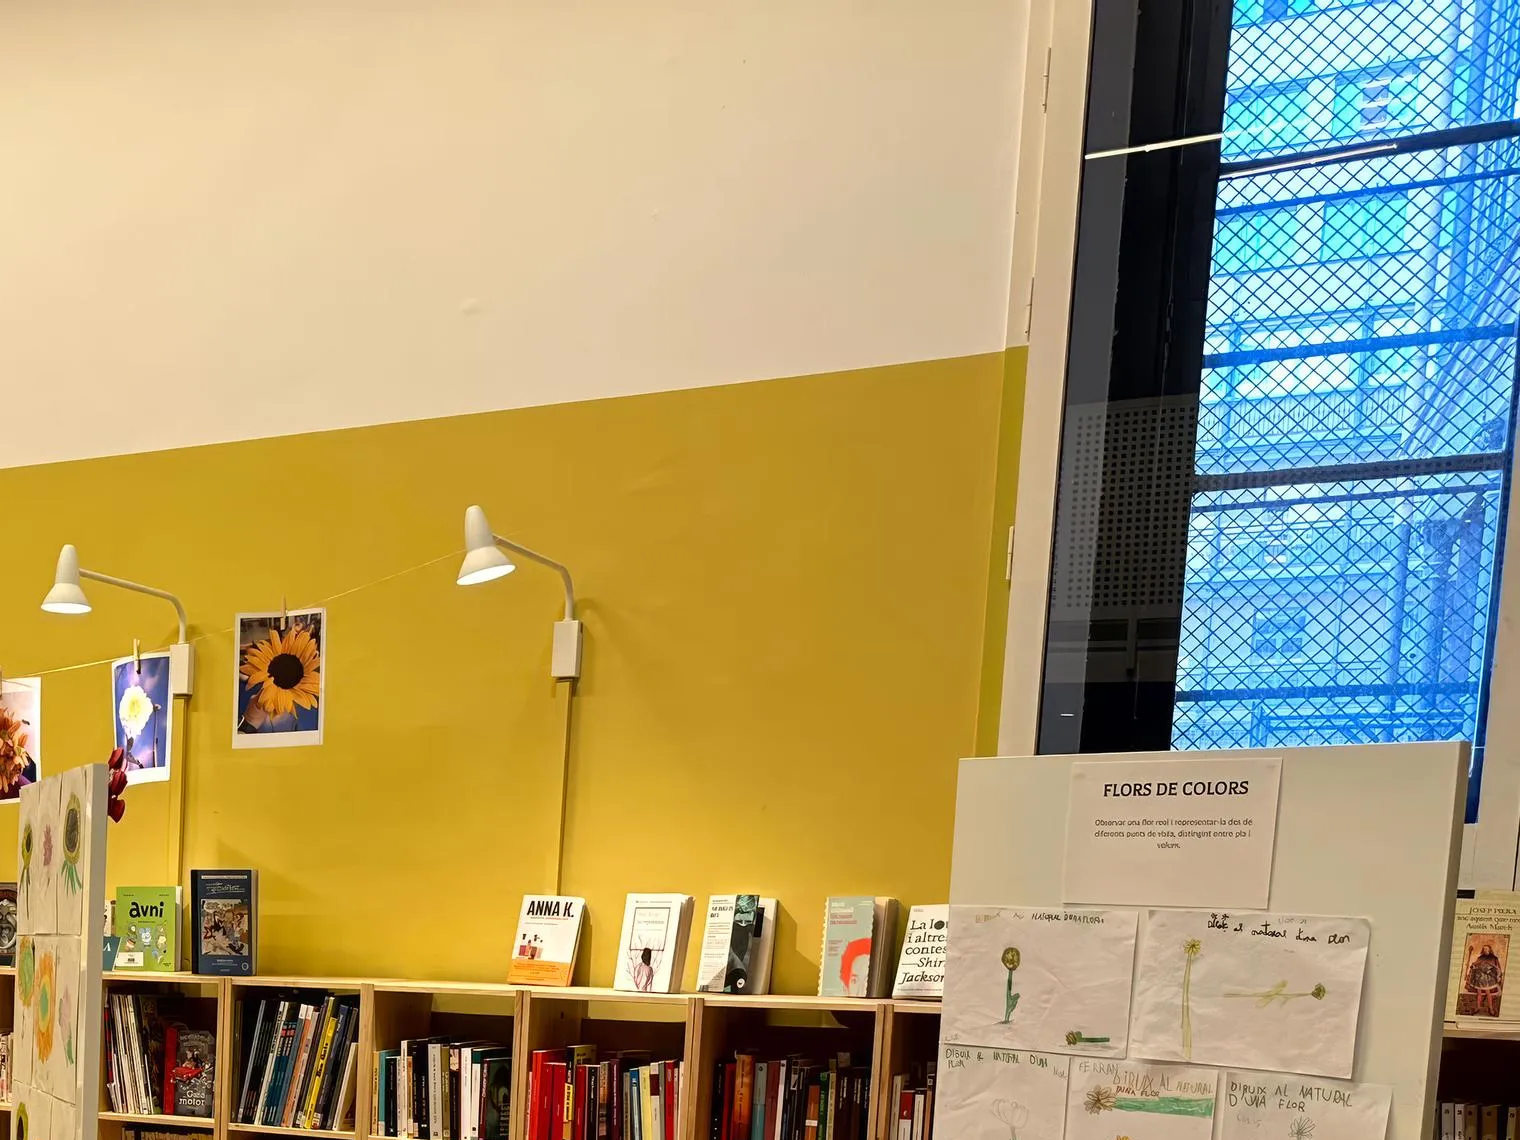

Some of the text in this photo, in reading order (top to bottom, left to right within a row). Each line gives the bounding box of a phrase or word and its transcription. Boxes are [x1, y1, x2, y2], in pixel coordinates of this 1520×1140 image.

[1103, 780, 1249, 797] FLORS DE COLORS
[1242, 817, 1253, 826] de
[129, 901, 165, 919] avni
[526, 900, 575, 918] ANNA K.
[909, 920, 927, 931] La
[1159, 1072, 1173, 1092] AL
[1274, 1083, 1289, 1097] AL
[1278, 1098, 1306, 1113] FLOR
